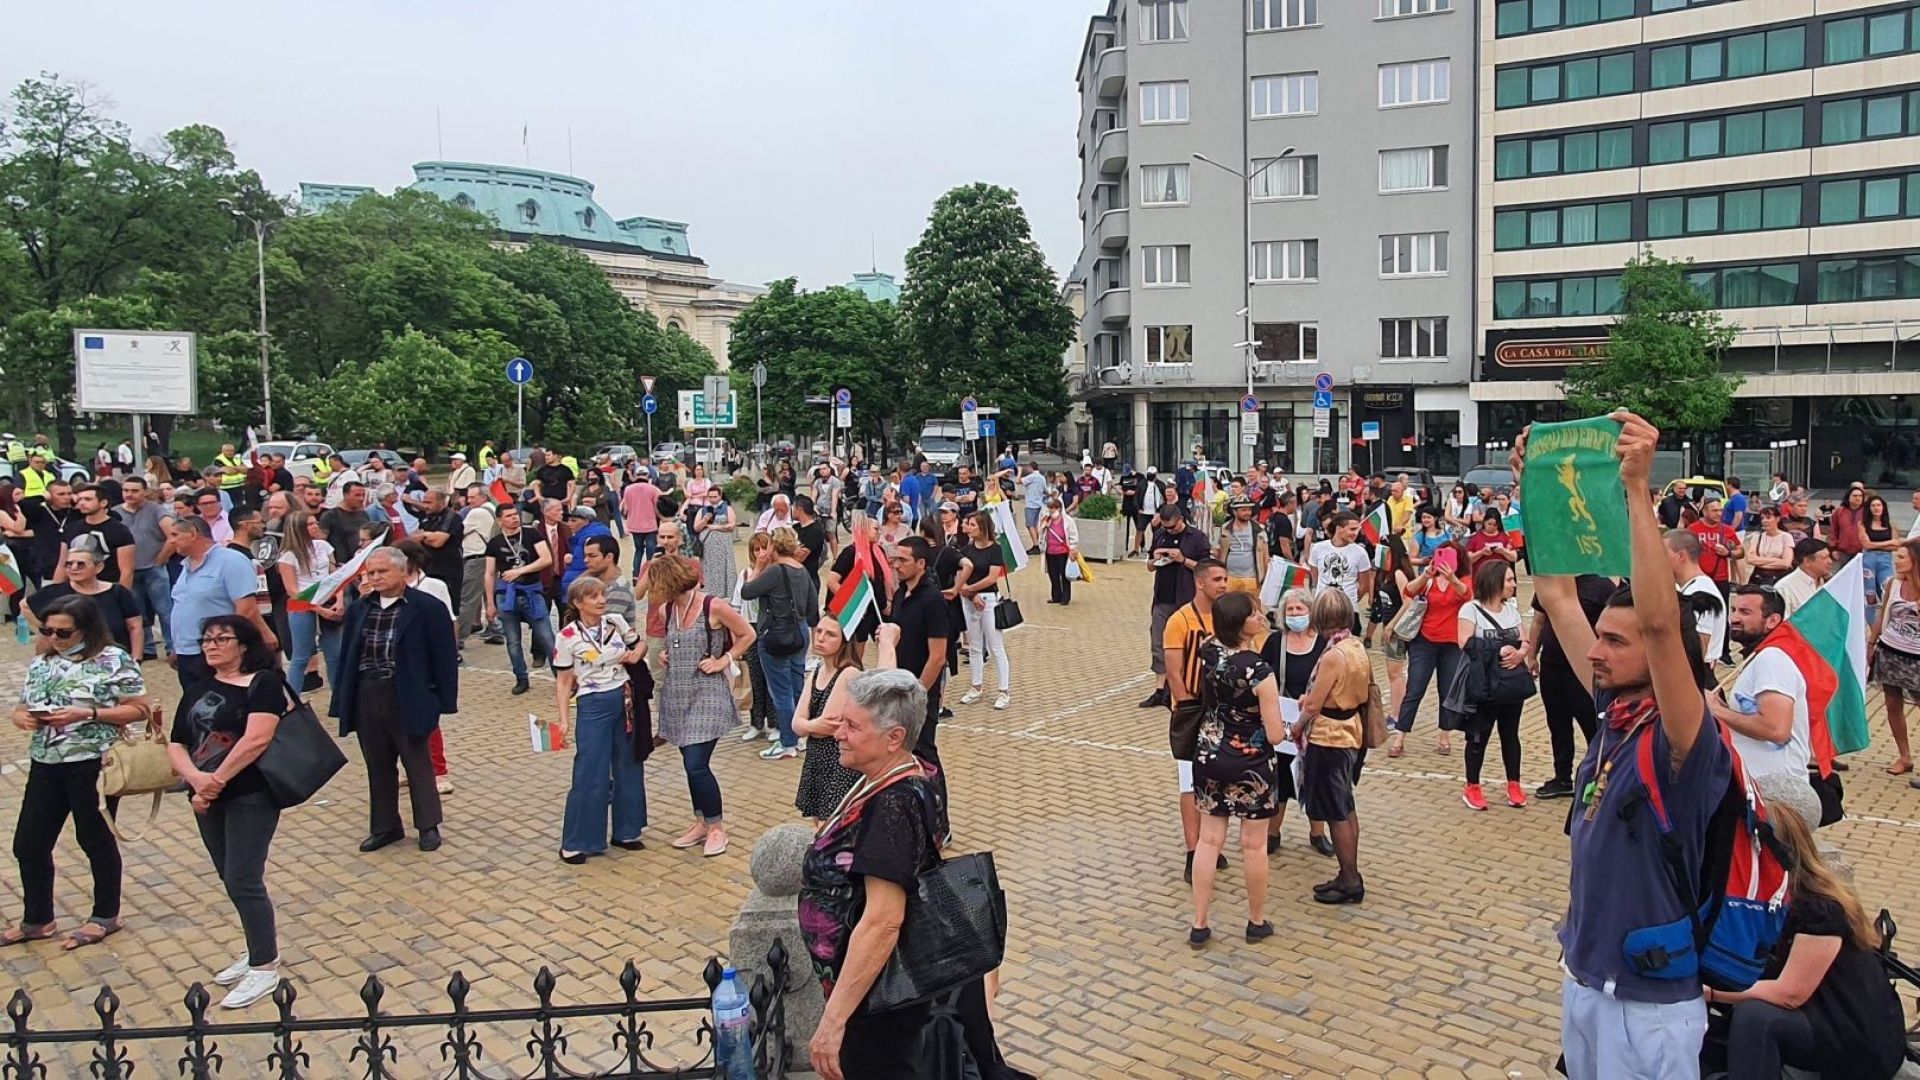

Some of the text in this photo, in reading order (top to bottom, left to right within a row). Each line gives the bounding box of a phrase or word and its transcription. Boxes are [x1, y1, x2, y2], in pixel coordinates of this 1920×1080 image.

[1504, 350, 1516, 358] LA
[1520, 347, 1551, 358] CASA
[1554, 349, 1574, 357] DEL
